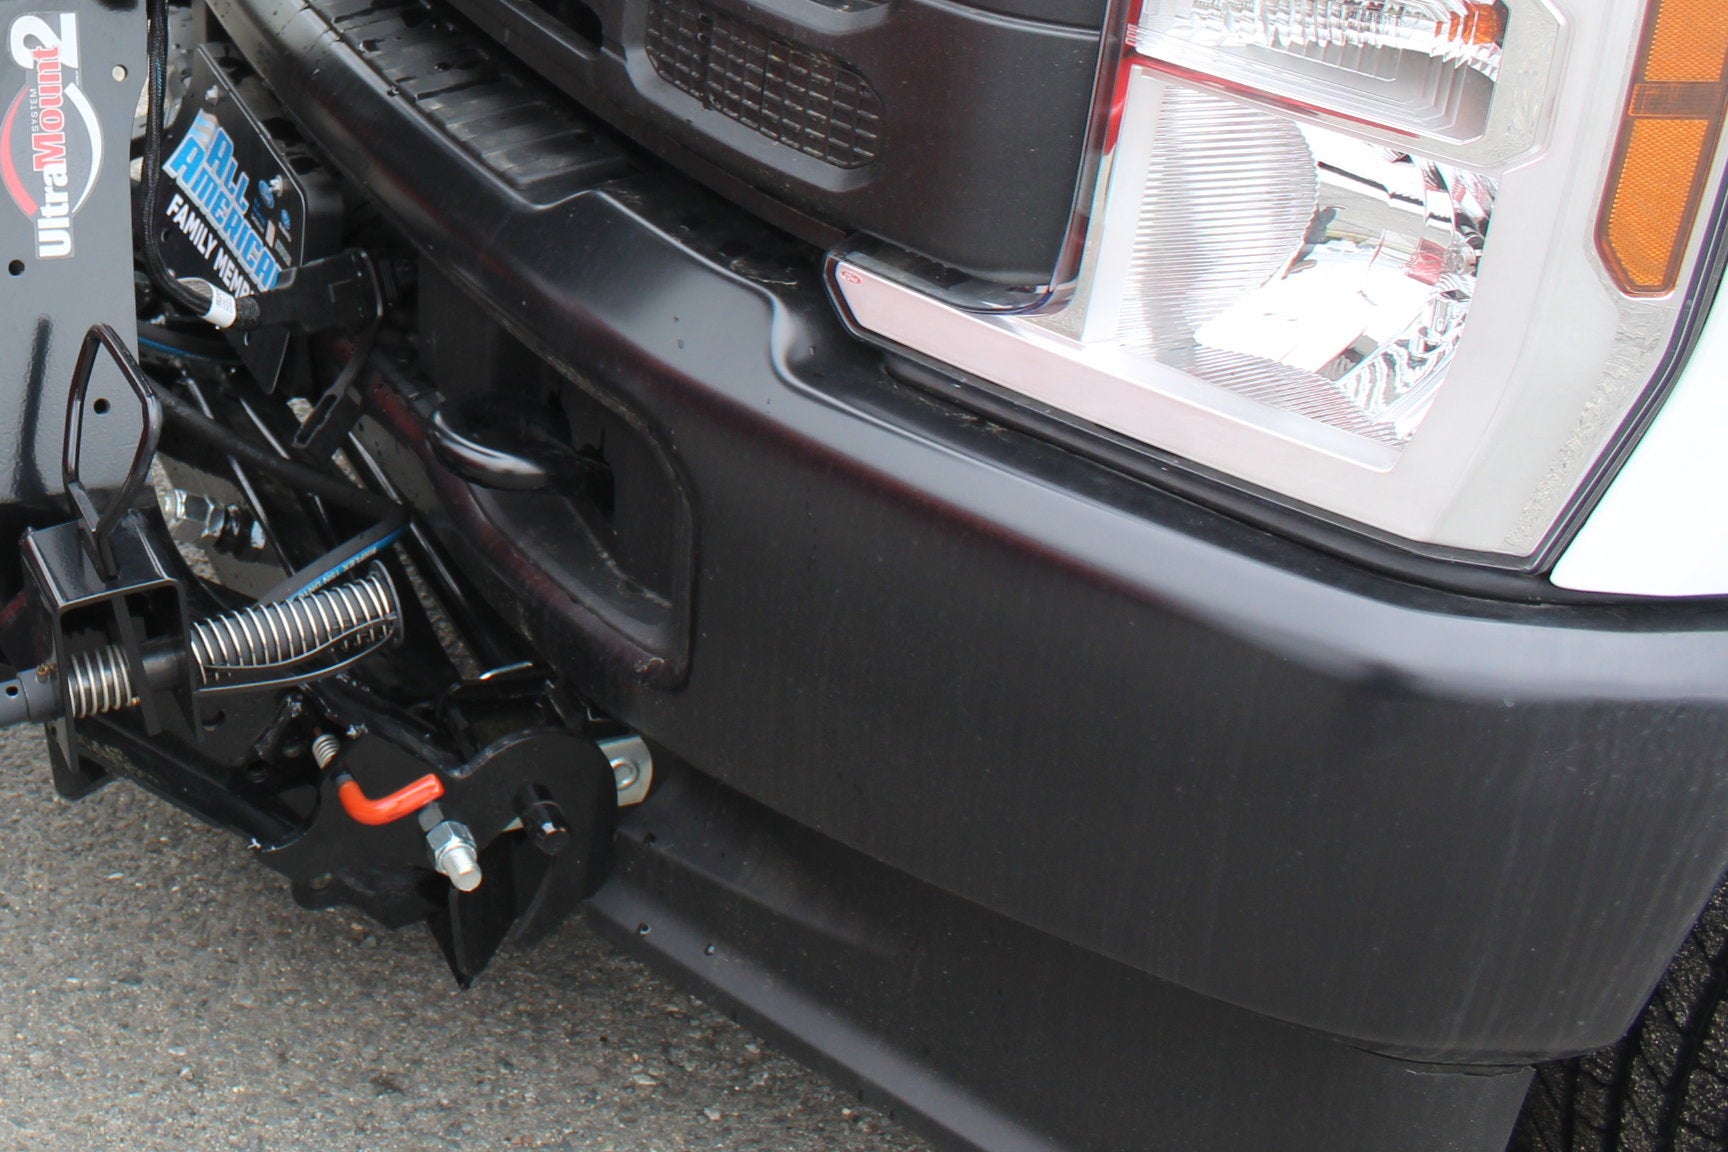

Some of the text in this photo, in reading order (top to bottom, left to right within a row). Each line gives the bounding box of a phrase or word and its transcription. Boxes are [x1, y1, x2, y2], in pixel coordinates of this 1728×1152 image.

[10, 13, 78, 257] UltraMount 2
[31, 88, 40, 132] SYSTEM
[206, 126, 250, 214] ALL
[166, 194, 218, 259] FAMILY
